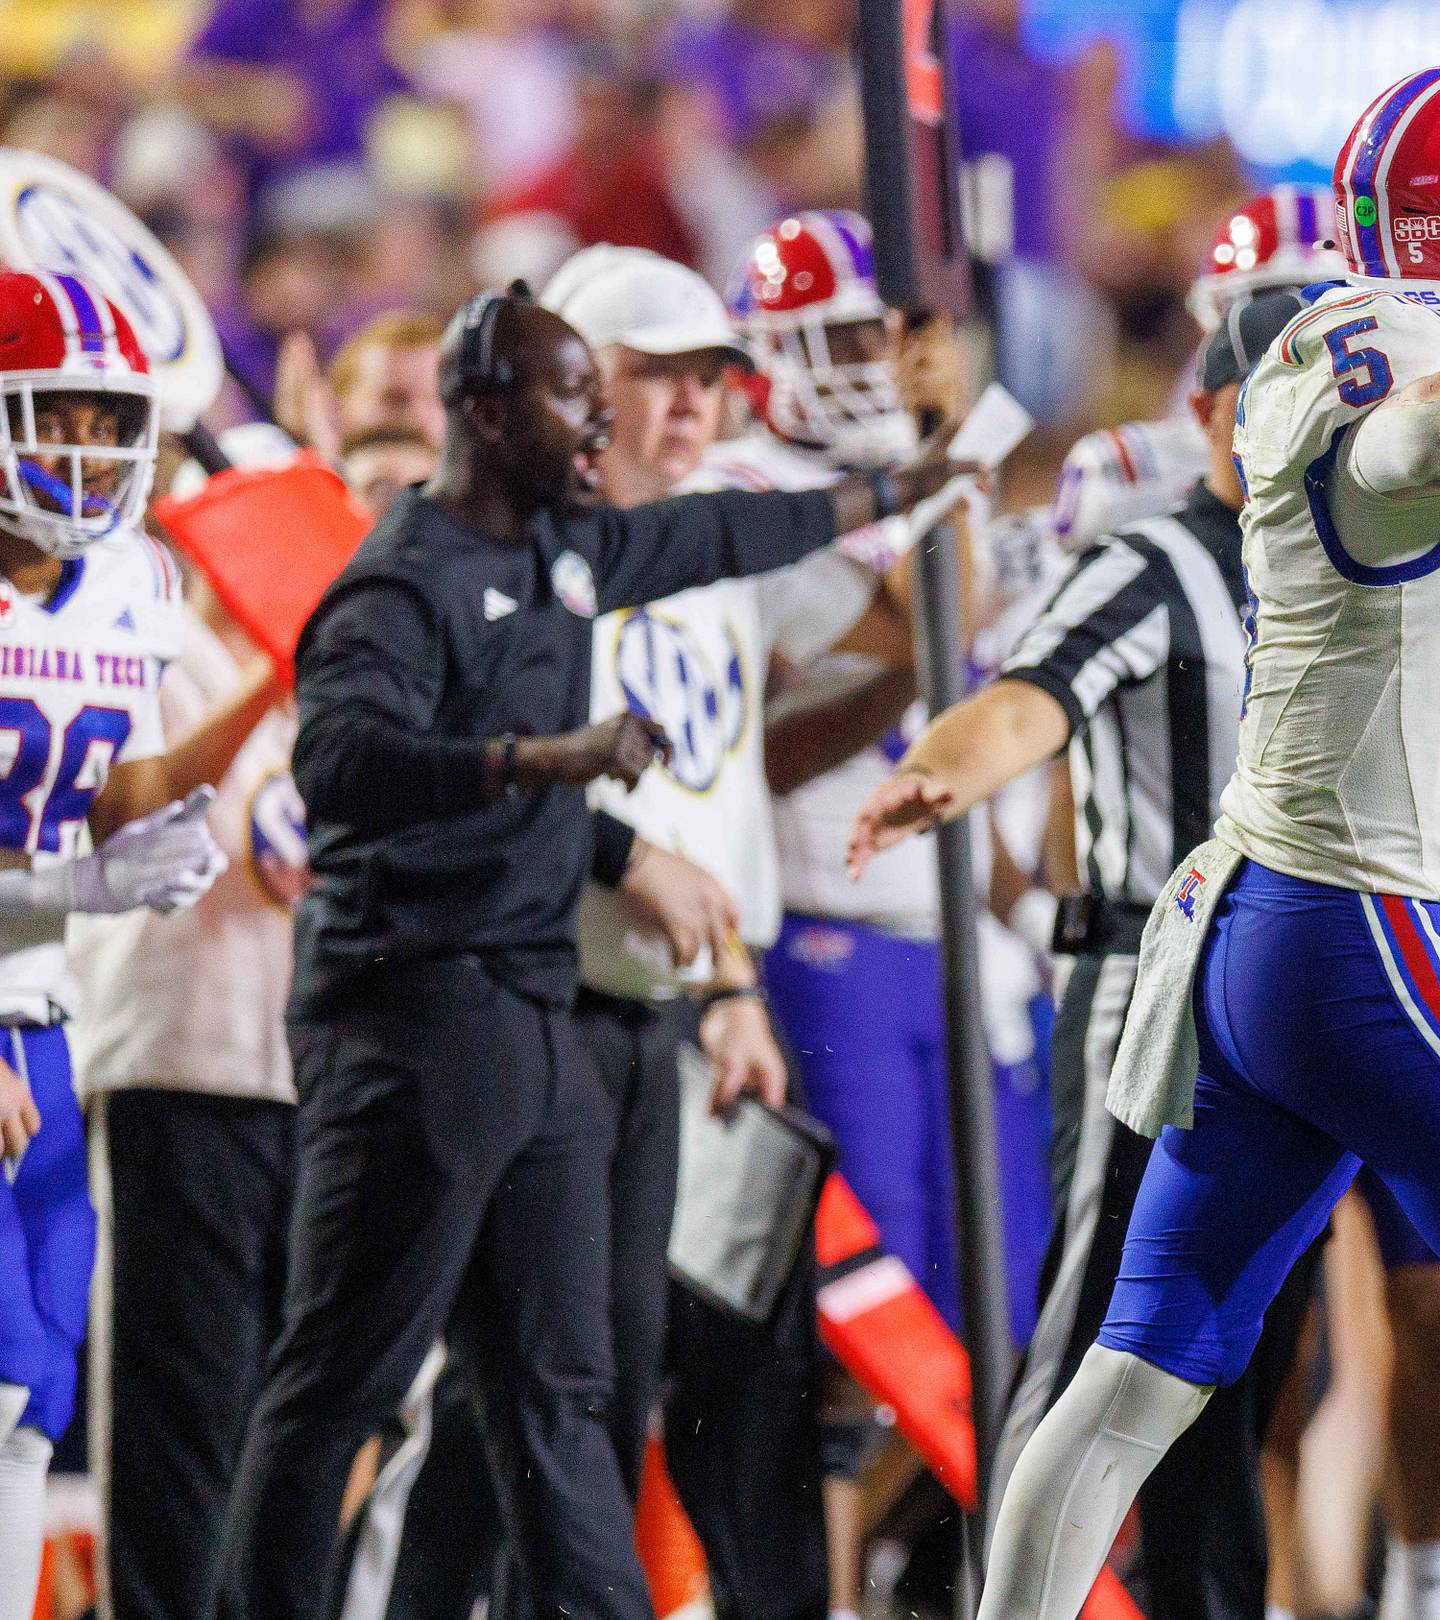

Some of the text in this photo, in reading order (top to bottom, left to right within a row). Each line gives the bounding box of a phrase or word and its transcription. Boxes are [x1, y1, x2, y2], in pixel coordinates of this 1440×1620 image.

[1356, 205, 1375, 217] C2P
[1407, 241, 1424, 264] 5
[1322, 315, 1394, 409] 5
